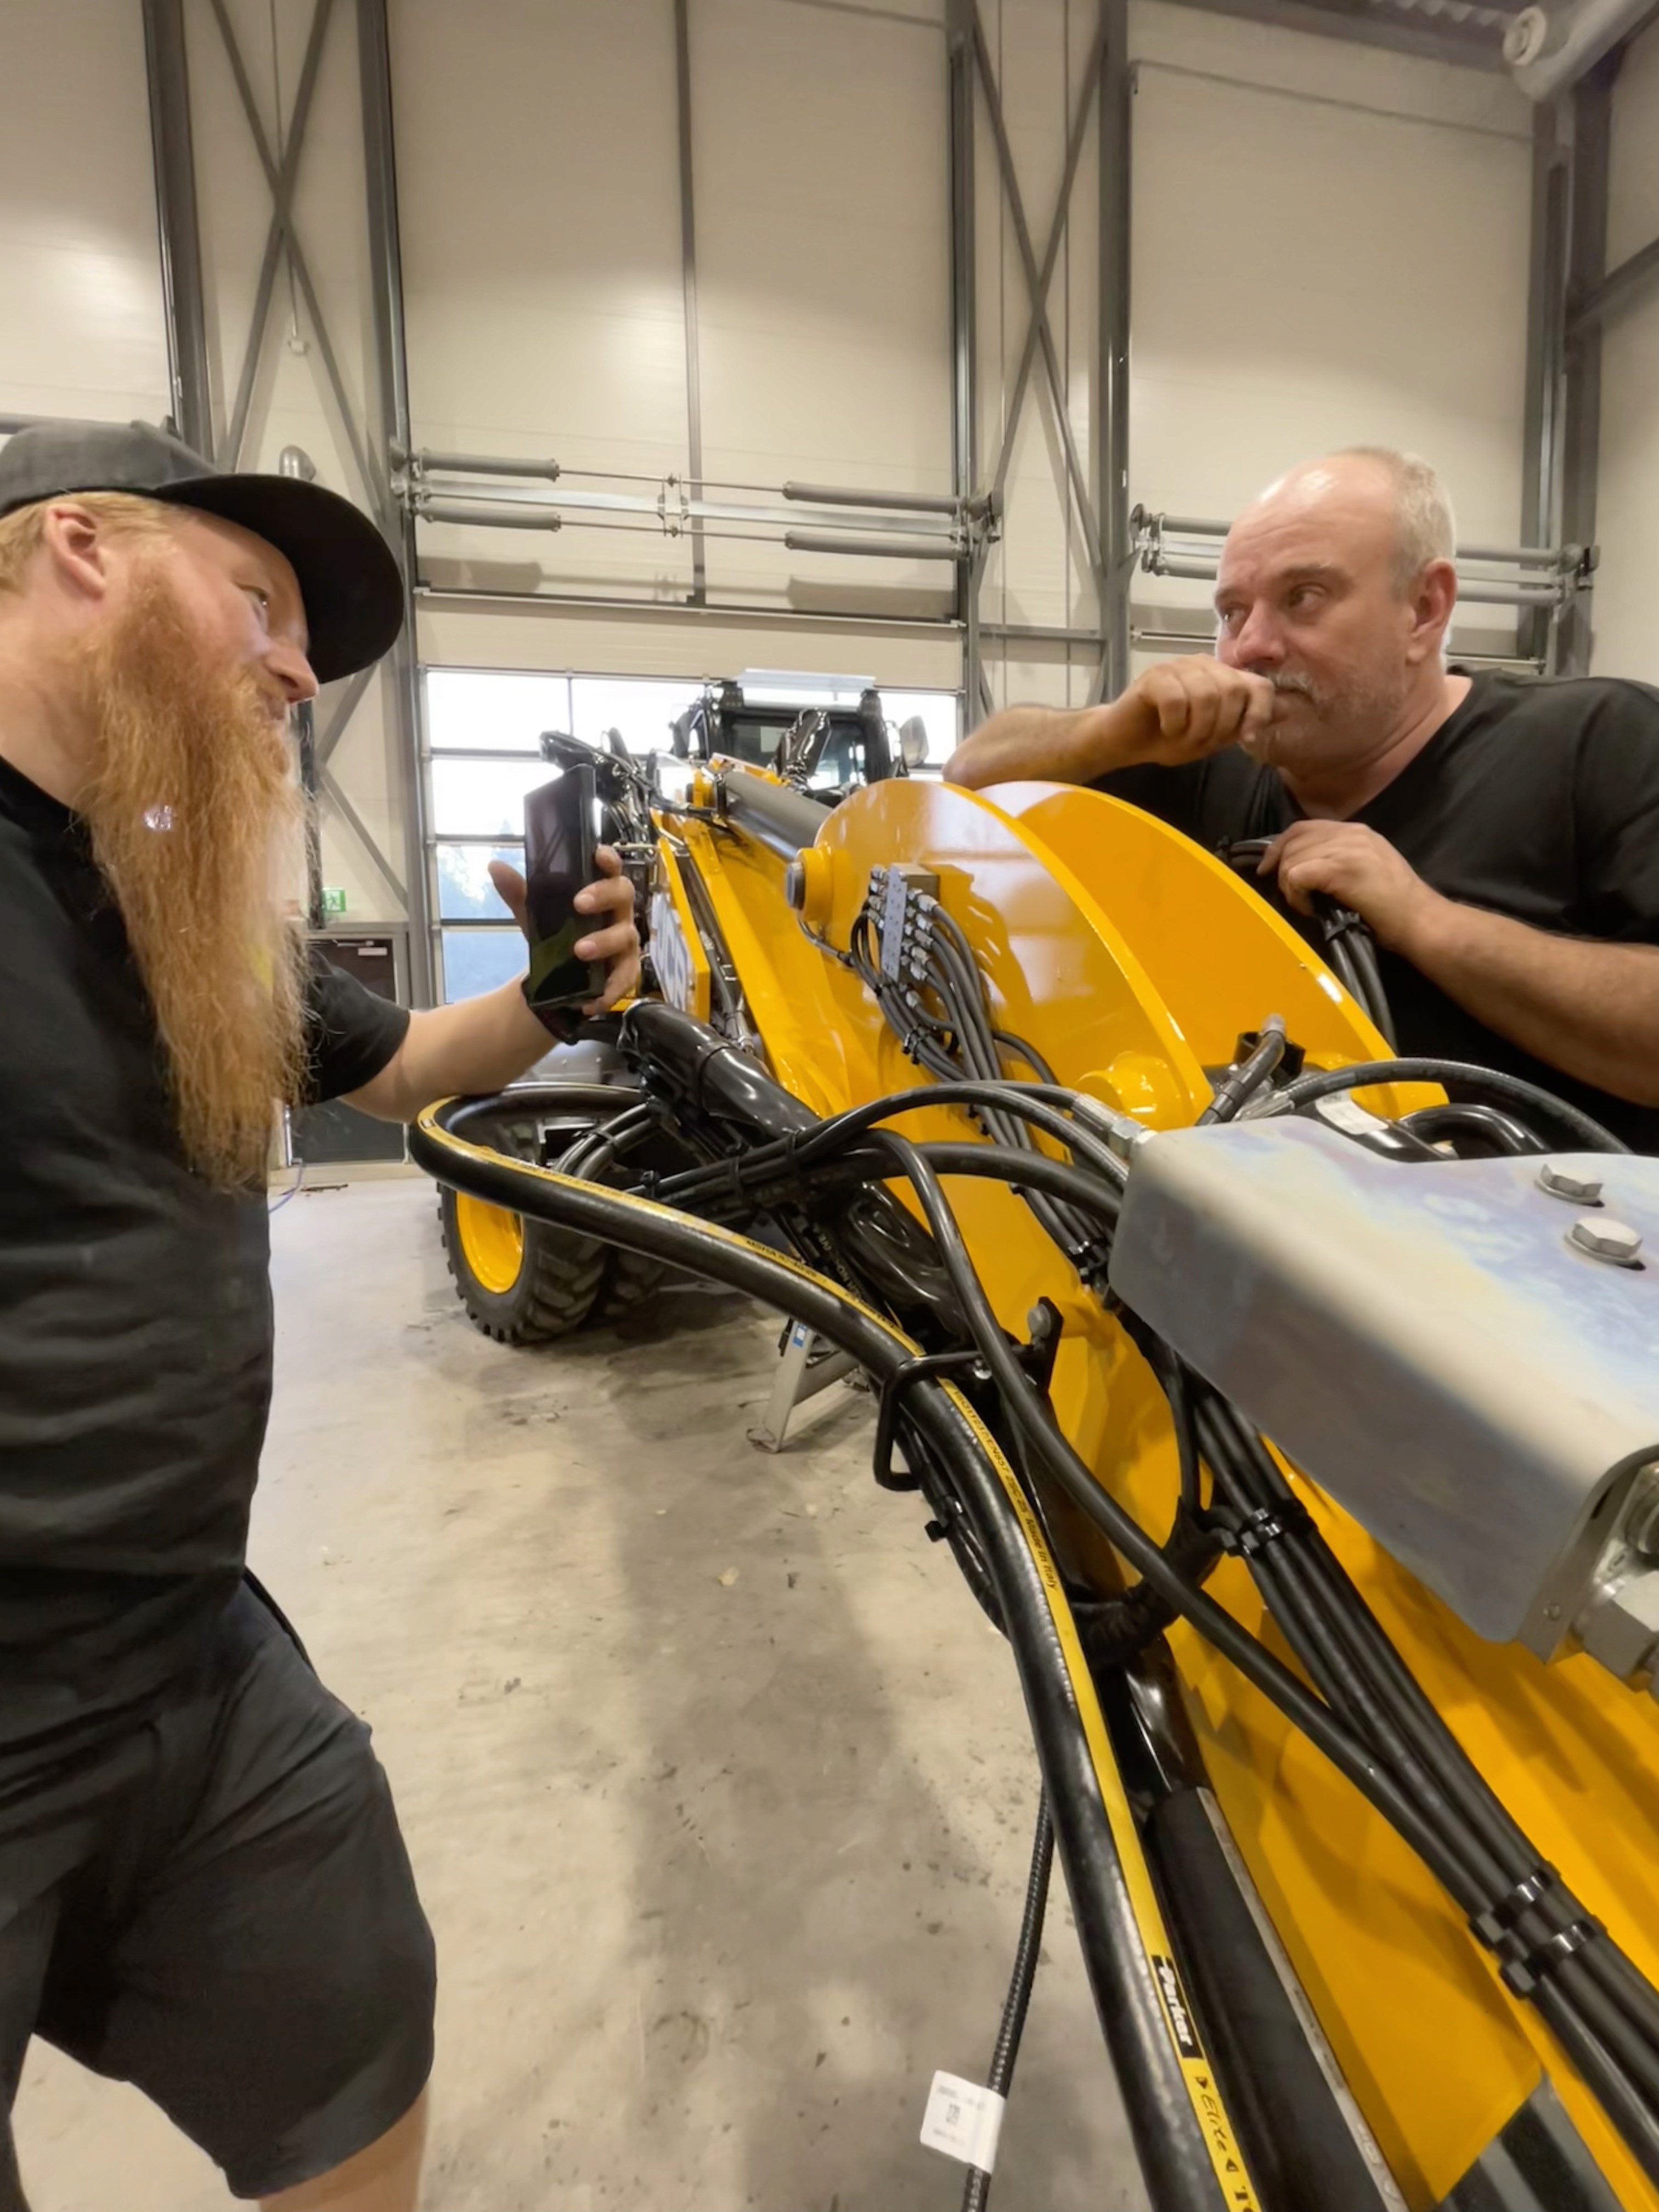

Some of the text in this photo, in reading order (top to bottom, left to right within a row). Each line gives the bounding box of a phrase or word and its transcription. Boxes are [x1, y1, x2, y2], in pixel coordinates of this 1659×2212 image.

[1025, 1517, 1042, 1549] Made
[1039, 1551, 1047, 1562] in
[1043, 1565, 1058, 1591] Italy
[1158, 1955, 1193, 2046] Parker
[1201, 2094, 1227, 2152] Elite
